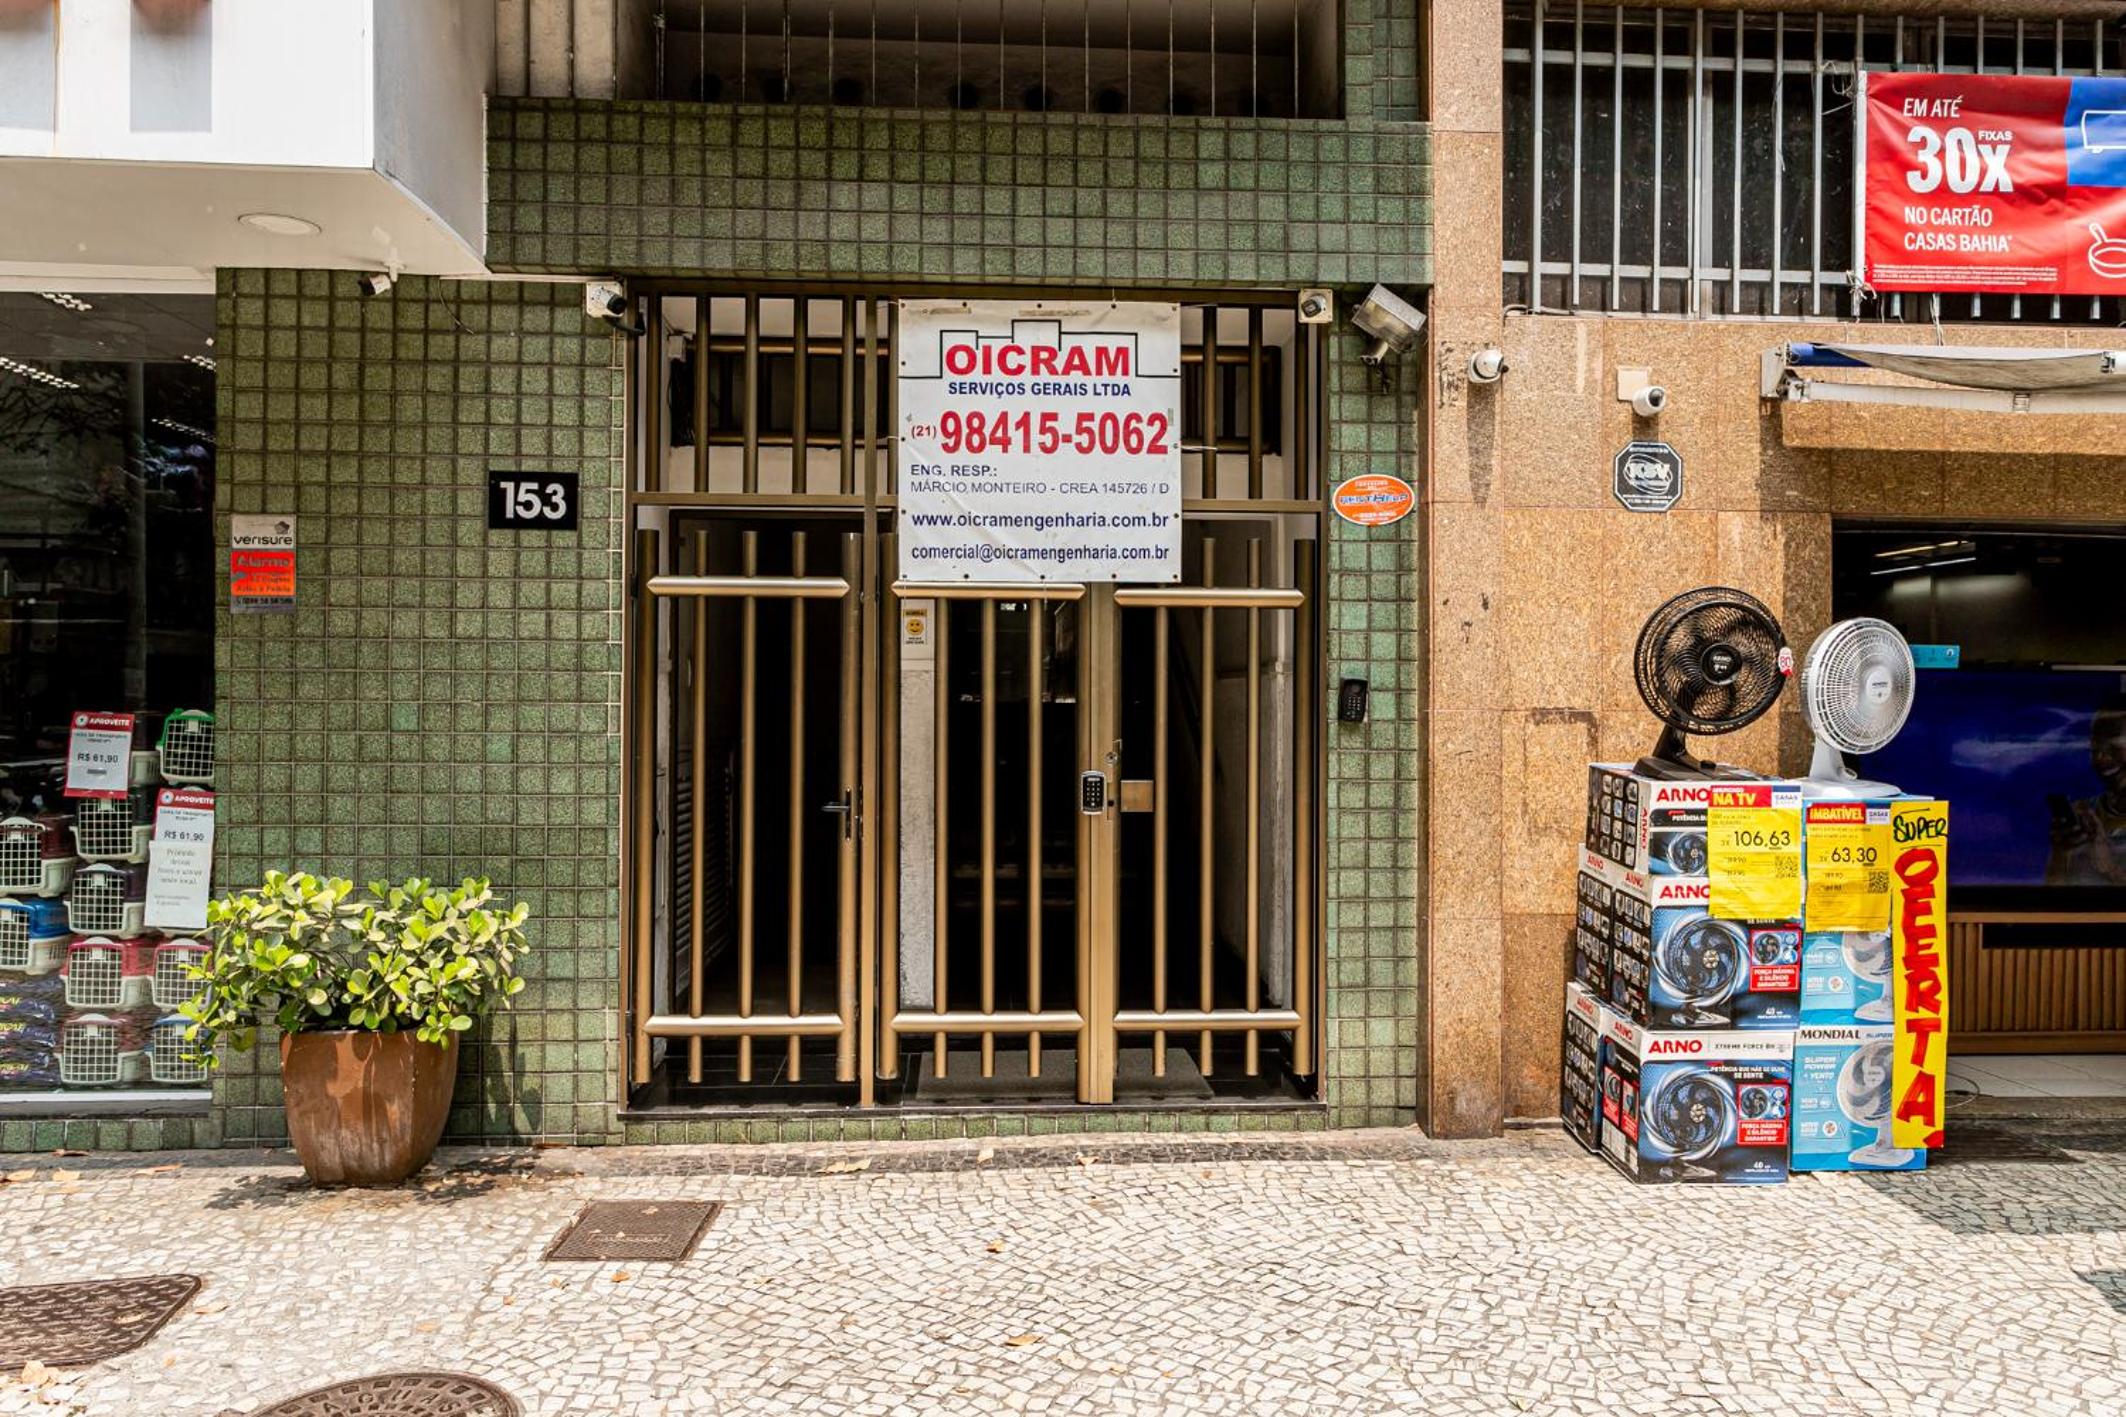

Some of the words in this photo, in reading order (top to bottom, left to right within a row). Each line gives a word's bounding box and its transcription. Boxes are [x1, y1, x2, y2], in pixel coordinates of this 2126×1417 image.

[1903, 97, 1927, 117] EM
[1932, 95, 1963, 118] ATÉ
[1978, 129, 2013, 141] FIXAS
[1904, 206, 1927, 225] NO
[1930, 205, 1993, 227] CARTÃO
[1904, 232, 1957, 251] CASAS
[945, 344, 1130, 376] OICRAM
[948, 382, 1026, 399] SERVIÇOS
[1031, 383, 1088, 396] GERAIS
[1093, 383, 1131, 396] LTDA
[911, 425, 937, 440] (21)
[940, 411, 1169, 455] 98415-5062
[911, 465, 946, 477] ENG.
[951, 465, 998, 477] RESP.:
[911, 480, 967, 494] MÁRCIO
[971, 483, 1047, 494] MONTEIRO
[1059, 483, 1098, 494] CREA
[1102, 483, 1147, 494] 145726
[1159, 484, 1169, 494] D
[500, 481, 567, 520] 153
[912, 512, 1169, 531] www.oicramengenharia.com.br
[233, 535, 293, 545] verisure
[912, 543, 1169, 563] comercial@oicramengenharia.com.br
[78, 753, 91, 762] R$
[1657, 788, 1711, 802] ARNO
[1712, 793, 1734, 805] NA
[1736, 793, 1757, 805] TV
[1809, 805, 1865, 821] IMBATÍVEL
[164, 830, 177, 840] R$
[1893, 815, 1948, 843] SUPER
[1734, 831, 1791, 847] 106,63
[1831, 847, 1878, 864] 63,30
[1800, 1029, 1861, 1040] MONDIAL
[1648, 1039, 1703, 1054] ARNO
